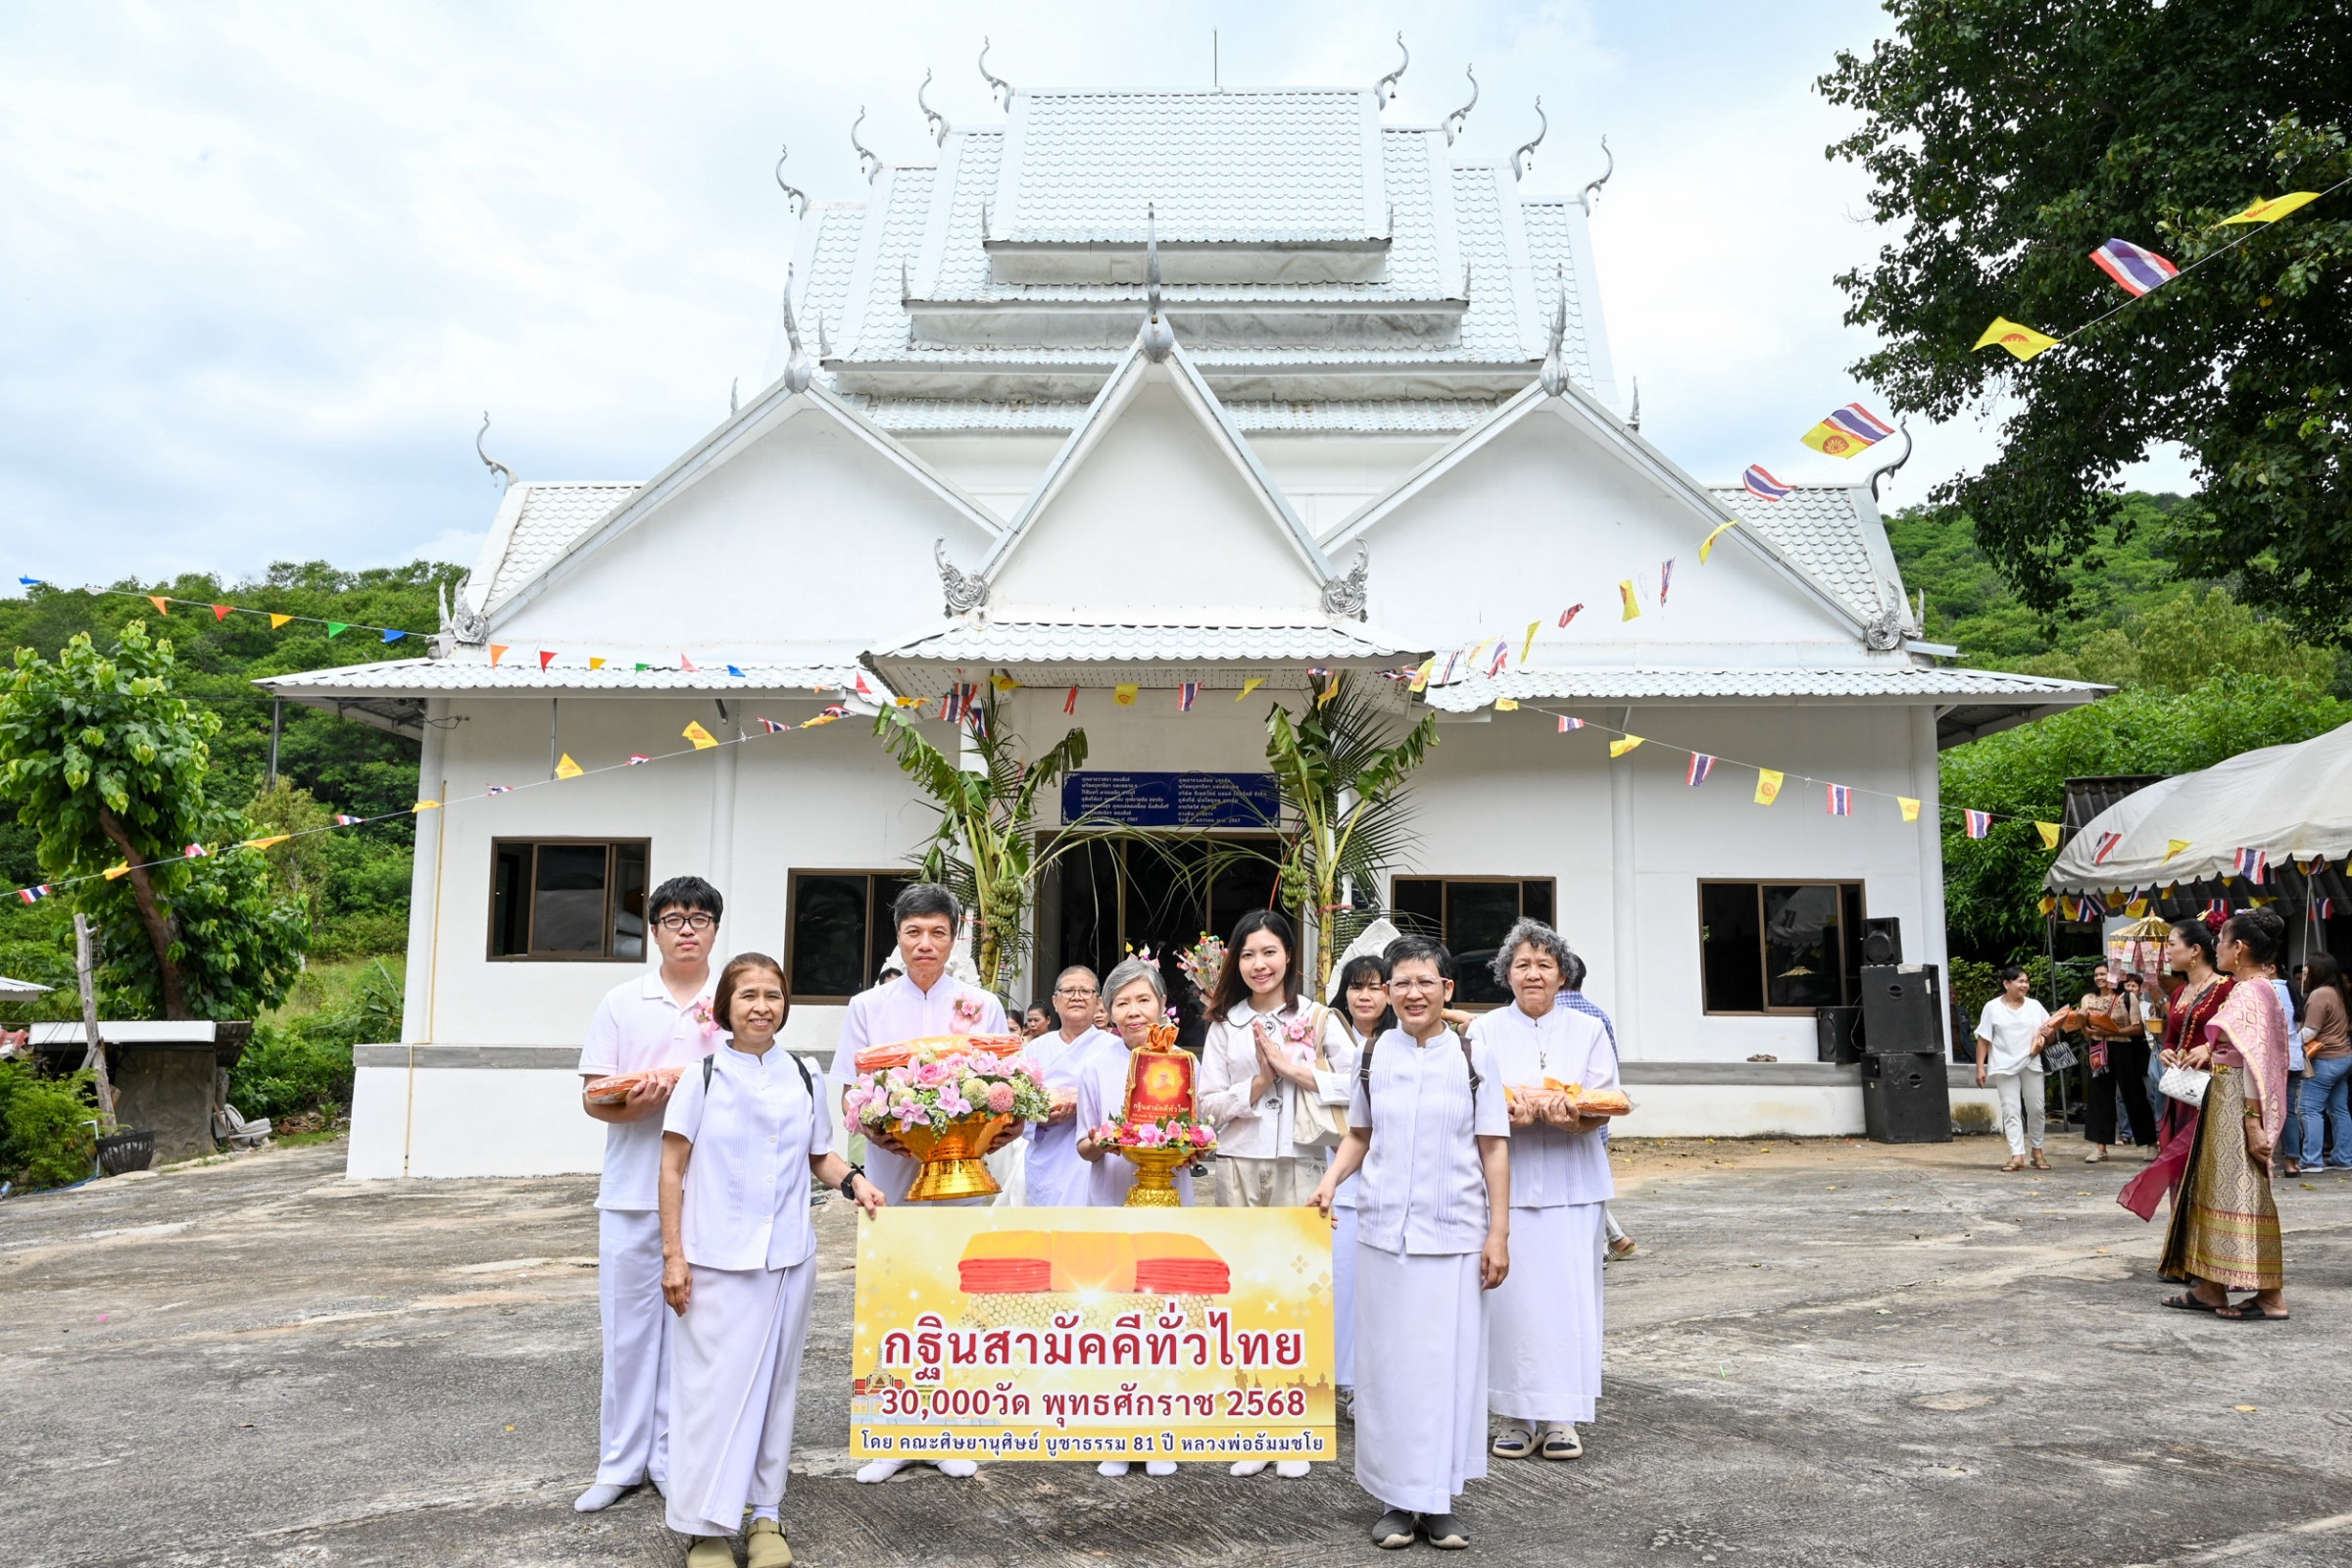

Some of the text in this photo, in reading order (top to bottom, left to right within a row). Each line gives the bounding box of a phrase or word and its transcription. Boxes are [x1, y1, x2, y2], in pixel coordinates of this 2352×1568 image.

[884, 1302, 1301, 1381] กฐินสามัคคีทั่วไทย
[881, 1381, 1305, 1428] 30,000วัด พุทธศักราช 2568
[860, 1429, 1323, 1456] โดย คณะศิษยานุศิษย์ บูชาธรรม 81 ปี หลวงพ่อธัมมชโย
